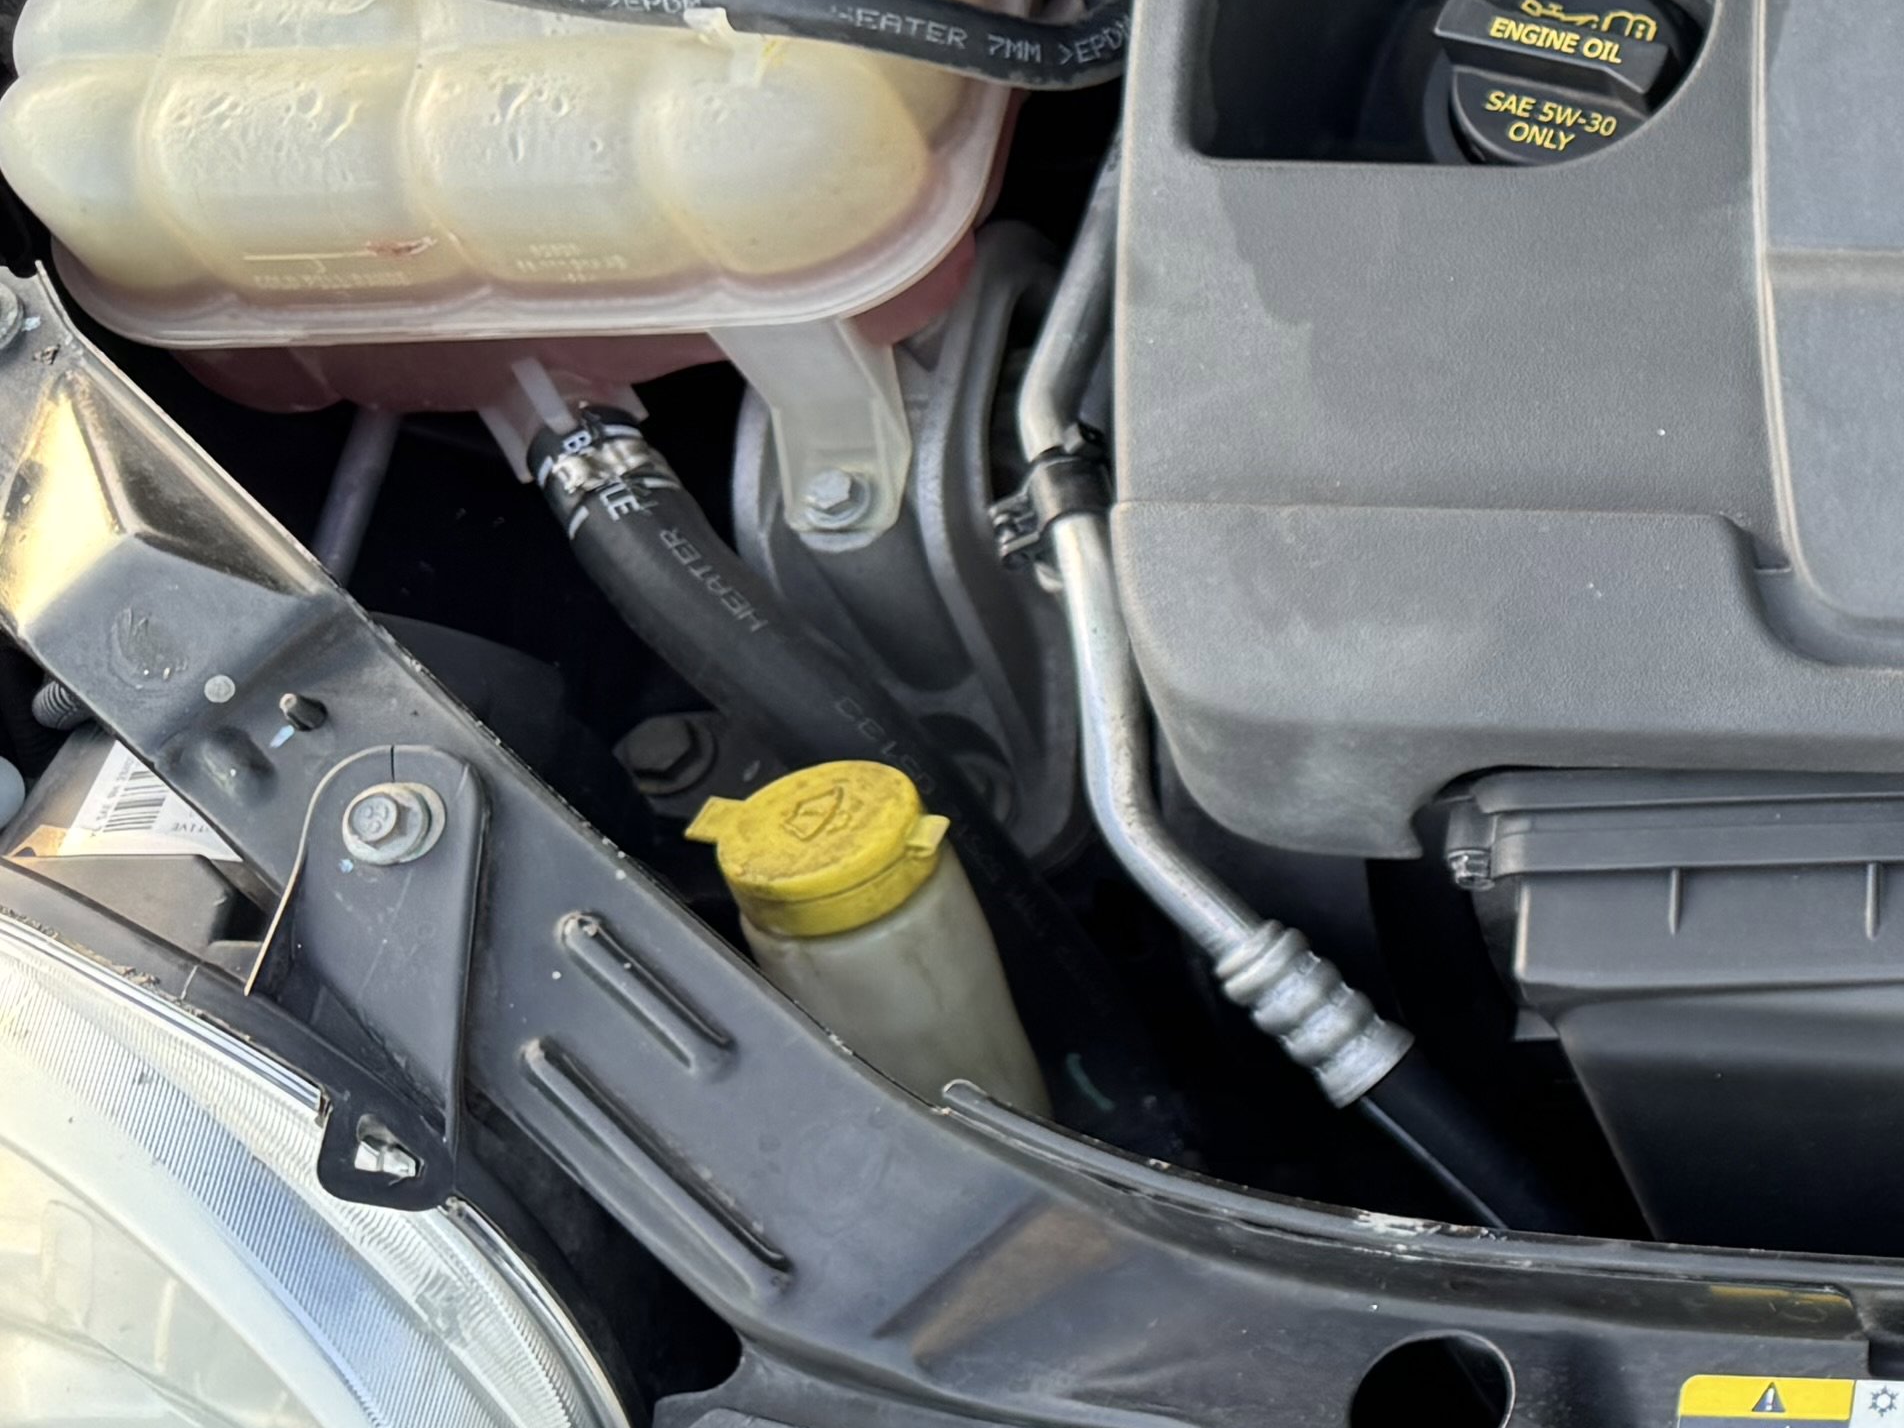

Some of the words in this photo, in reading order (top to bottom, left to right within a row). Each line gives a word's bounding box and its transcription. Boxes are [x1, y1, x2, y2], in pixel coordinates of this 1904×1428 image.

[987, 34, 1042, 64] 7MM
[1489, 16, 1580, 54] ENGINE
[1582, 37, 1622, 65] OIL
[1485, 90, 1536, 118] SAE
[1539, 102, 1618, 136] 5W-30
[1508, 122, 1575, 152] ONLY
[659, 527, 769, 633] HEATER
